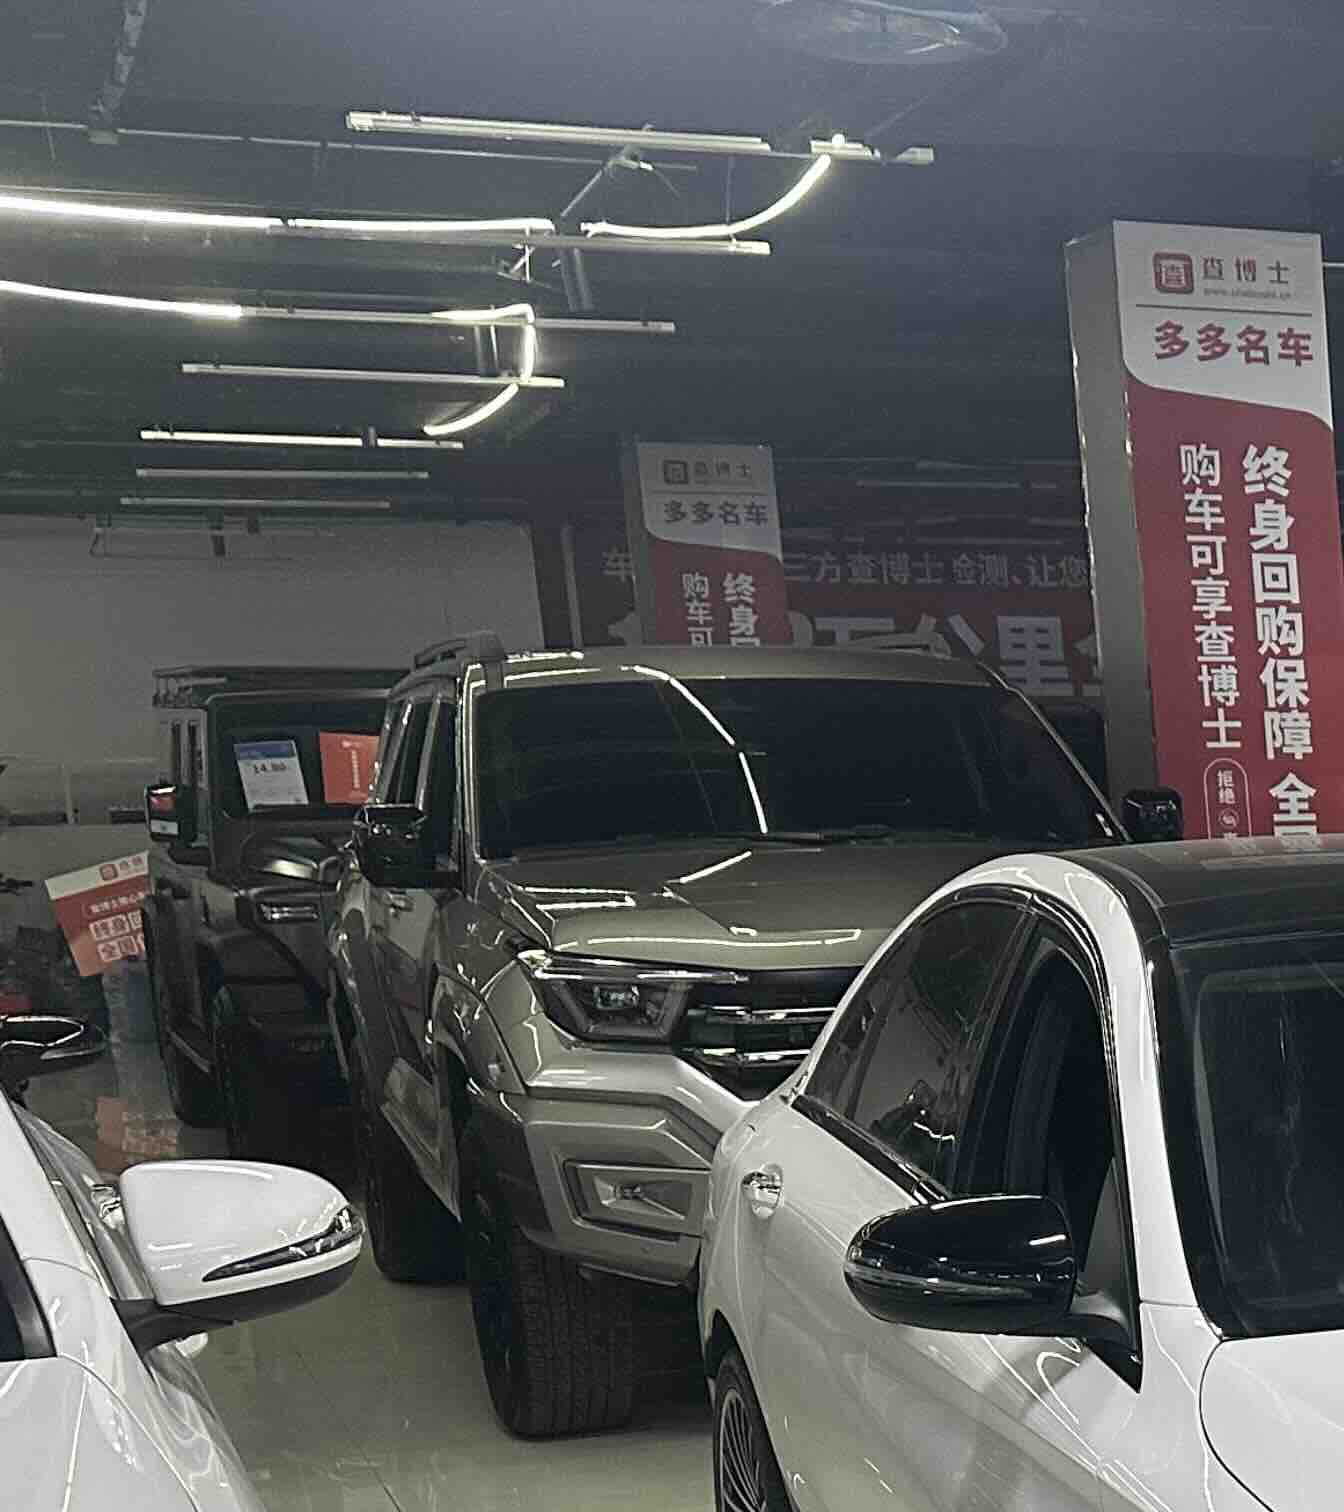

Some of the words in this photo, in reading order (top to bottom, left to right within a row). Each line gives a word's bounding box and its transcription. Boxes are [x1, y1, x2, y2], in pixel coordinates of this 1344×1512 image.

[1155, 319, 1314, 367] 多多名车
[664, 500, 768, 526] 多多名车
[682, 573, 714, 647] 购车可
[1179, 443, 1241, 749] 购车可享查博士
[1241, 444, 1313, 760] 终身回购保障
[1269, 772, 1317, 838] 全
